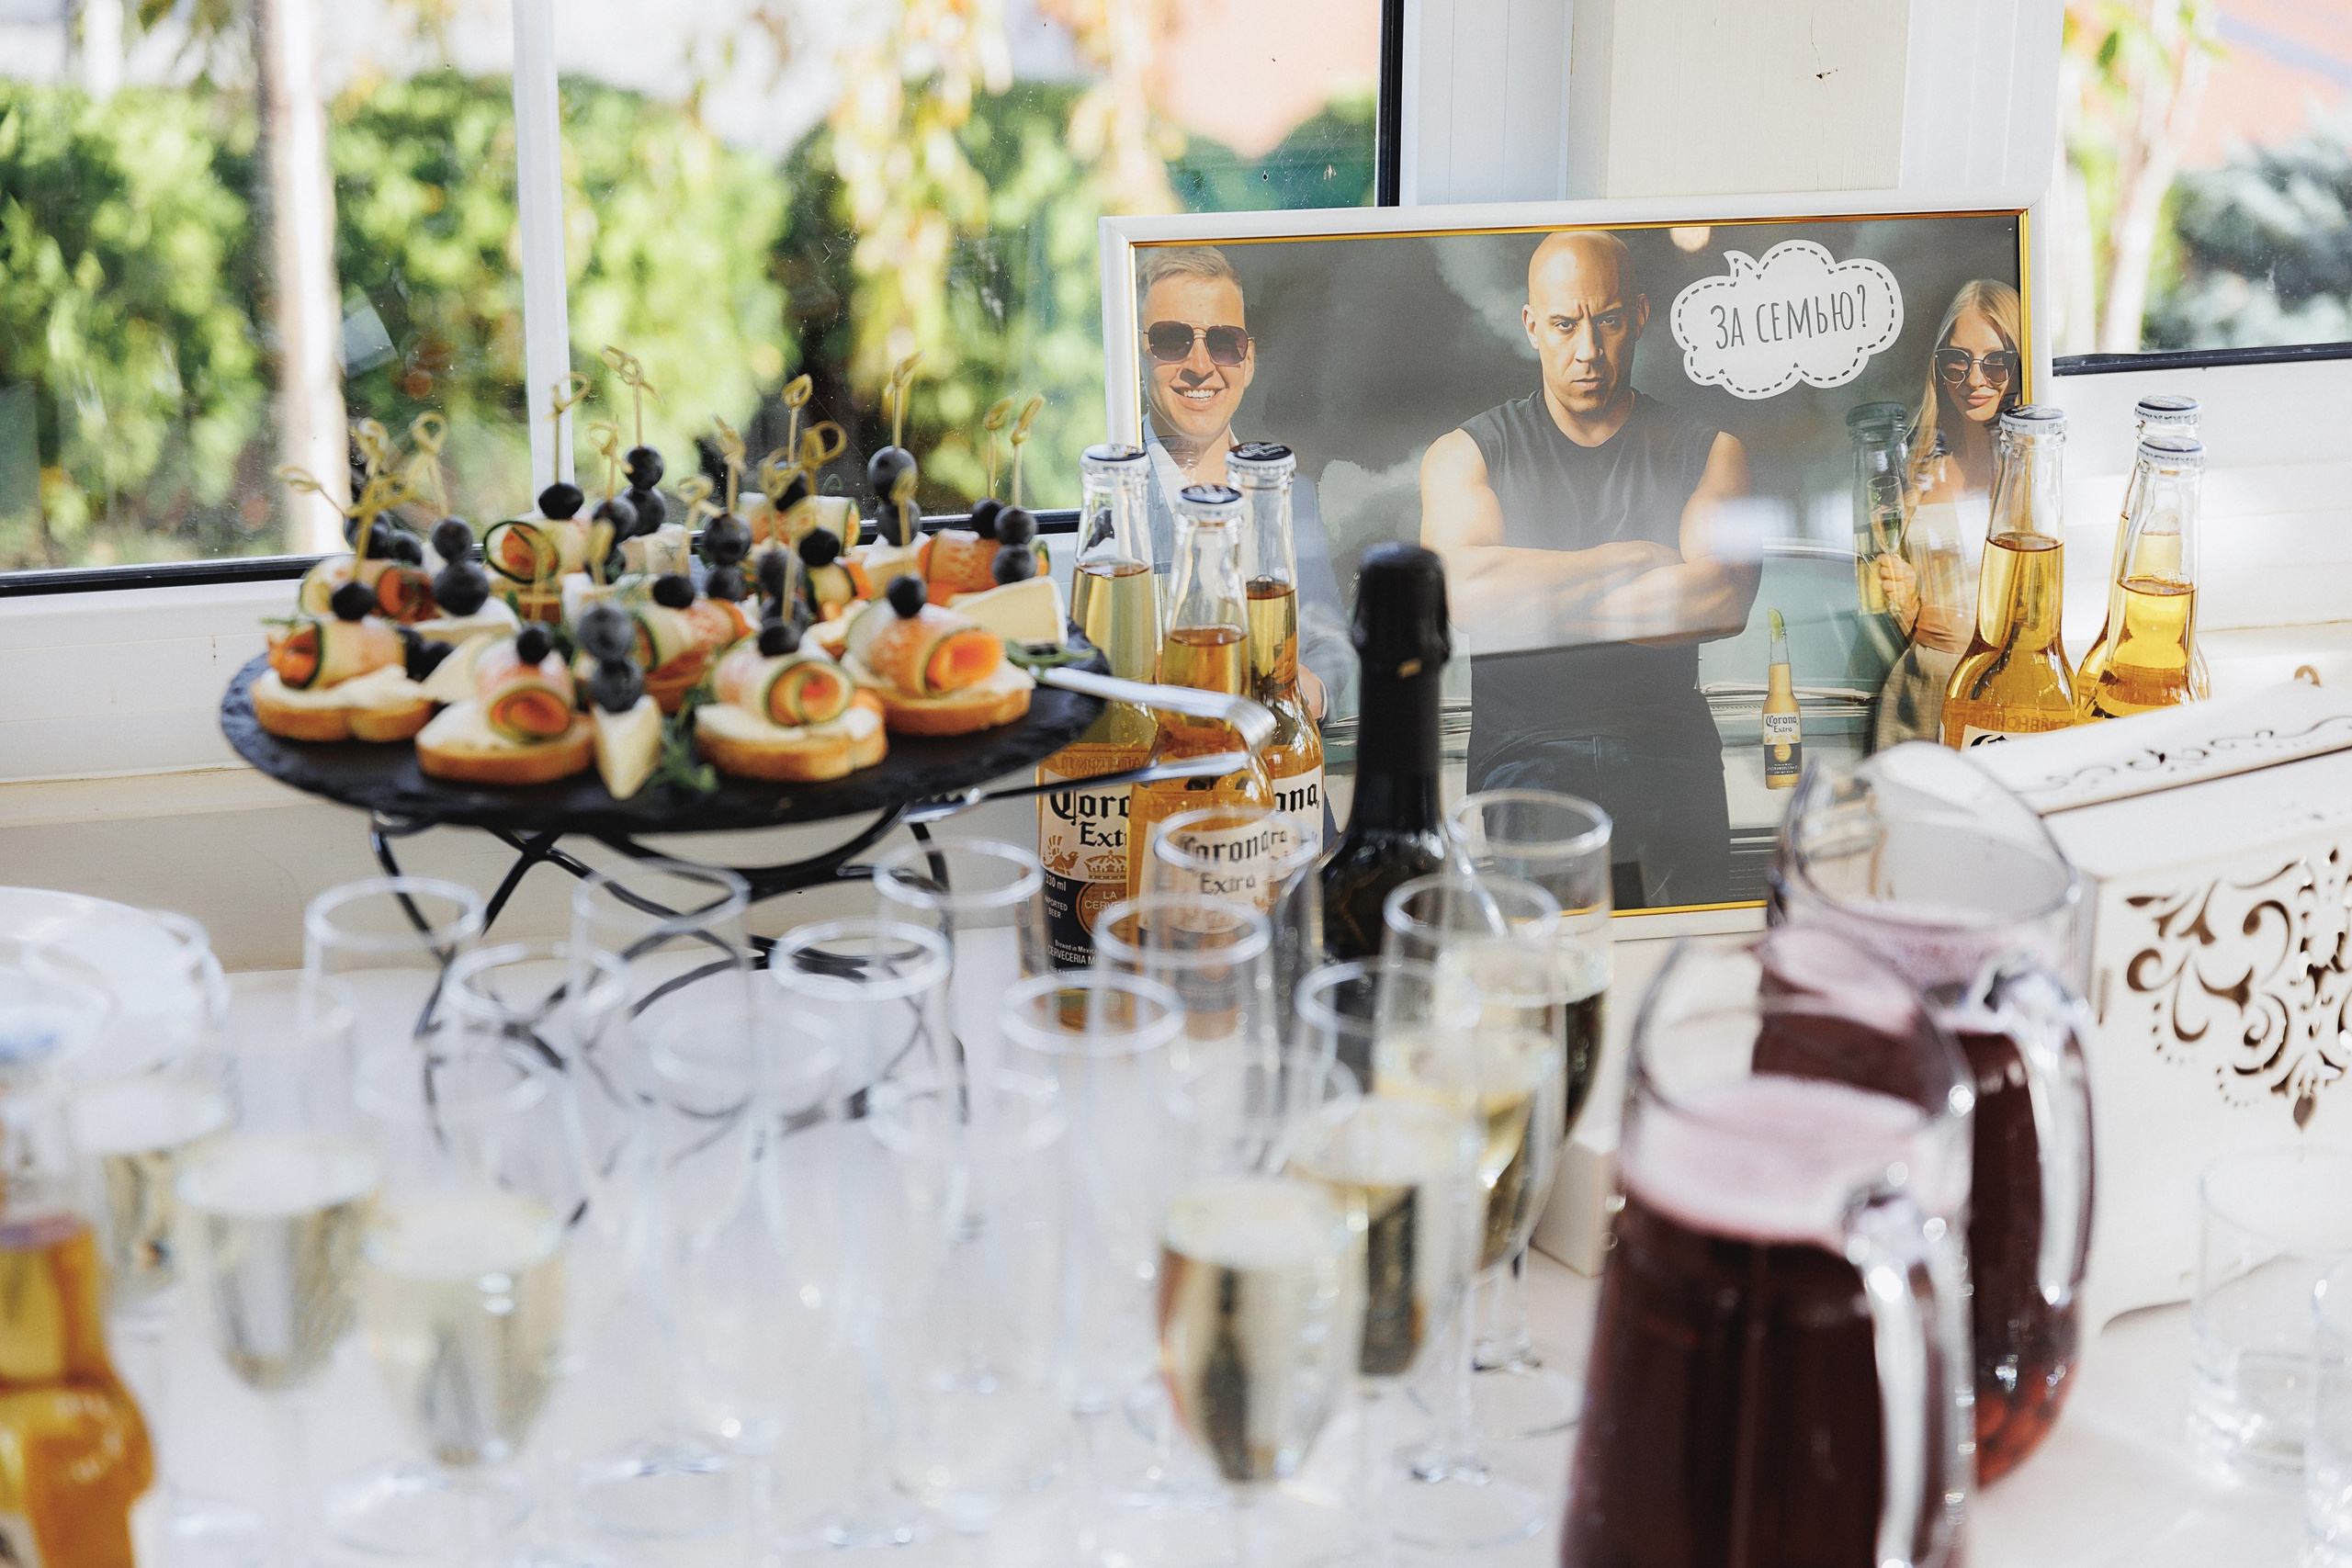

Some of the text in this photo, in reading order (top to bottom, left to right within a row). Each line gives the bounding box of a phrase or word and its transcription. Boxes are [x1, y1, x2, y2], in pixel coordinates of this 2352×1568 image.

[1710, 284, 1867, 350] ЗА СЕМЬЮ?
[1765, 715, 1797, 728] Corona
[1049, 790, 1130, 826] Coro
[1274, 783, 1317, 813] ona
[1079, 820, 1127, 847] Ext
[1057, 880, 1067, 892] ml
[1200, 872, 1255, 895] Extra
[1045, 895, 1069, 912] MPORTED
[1102, 891, 1118, 900] LA
[1048, 907, 1062, 919] BEER
[1047, 944, 1087, 965] CERVECERIA
